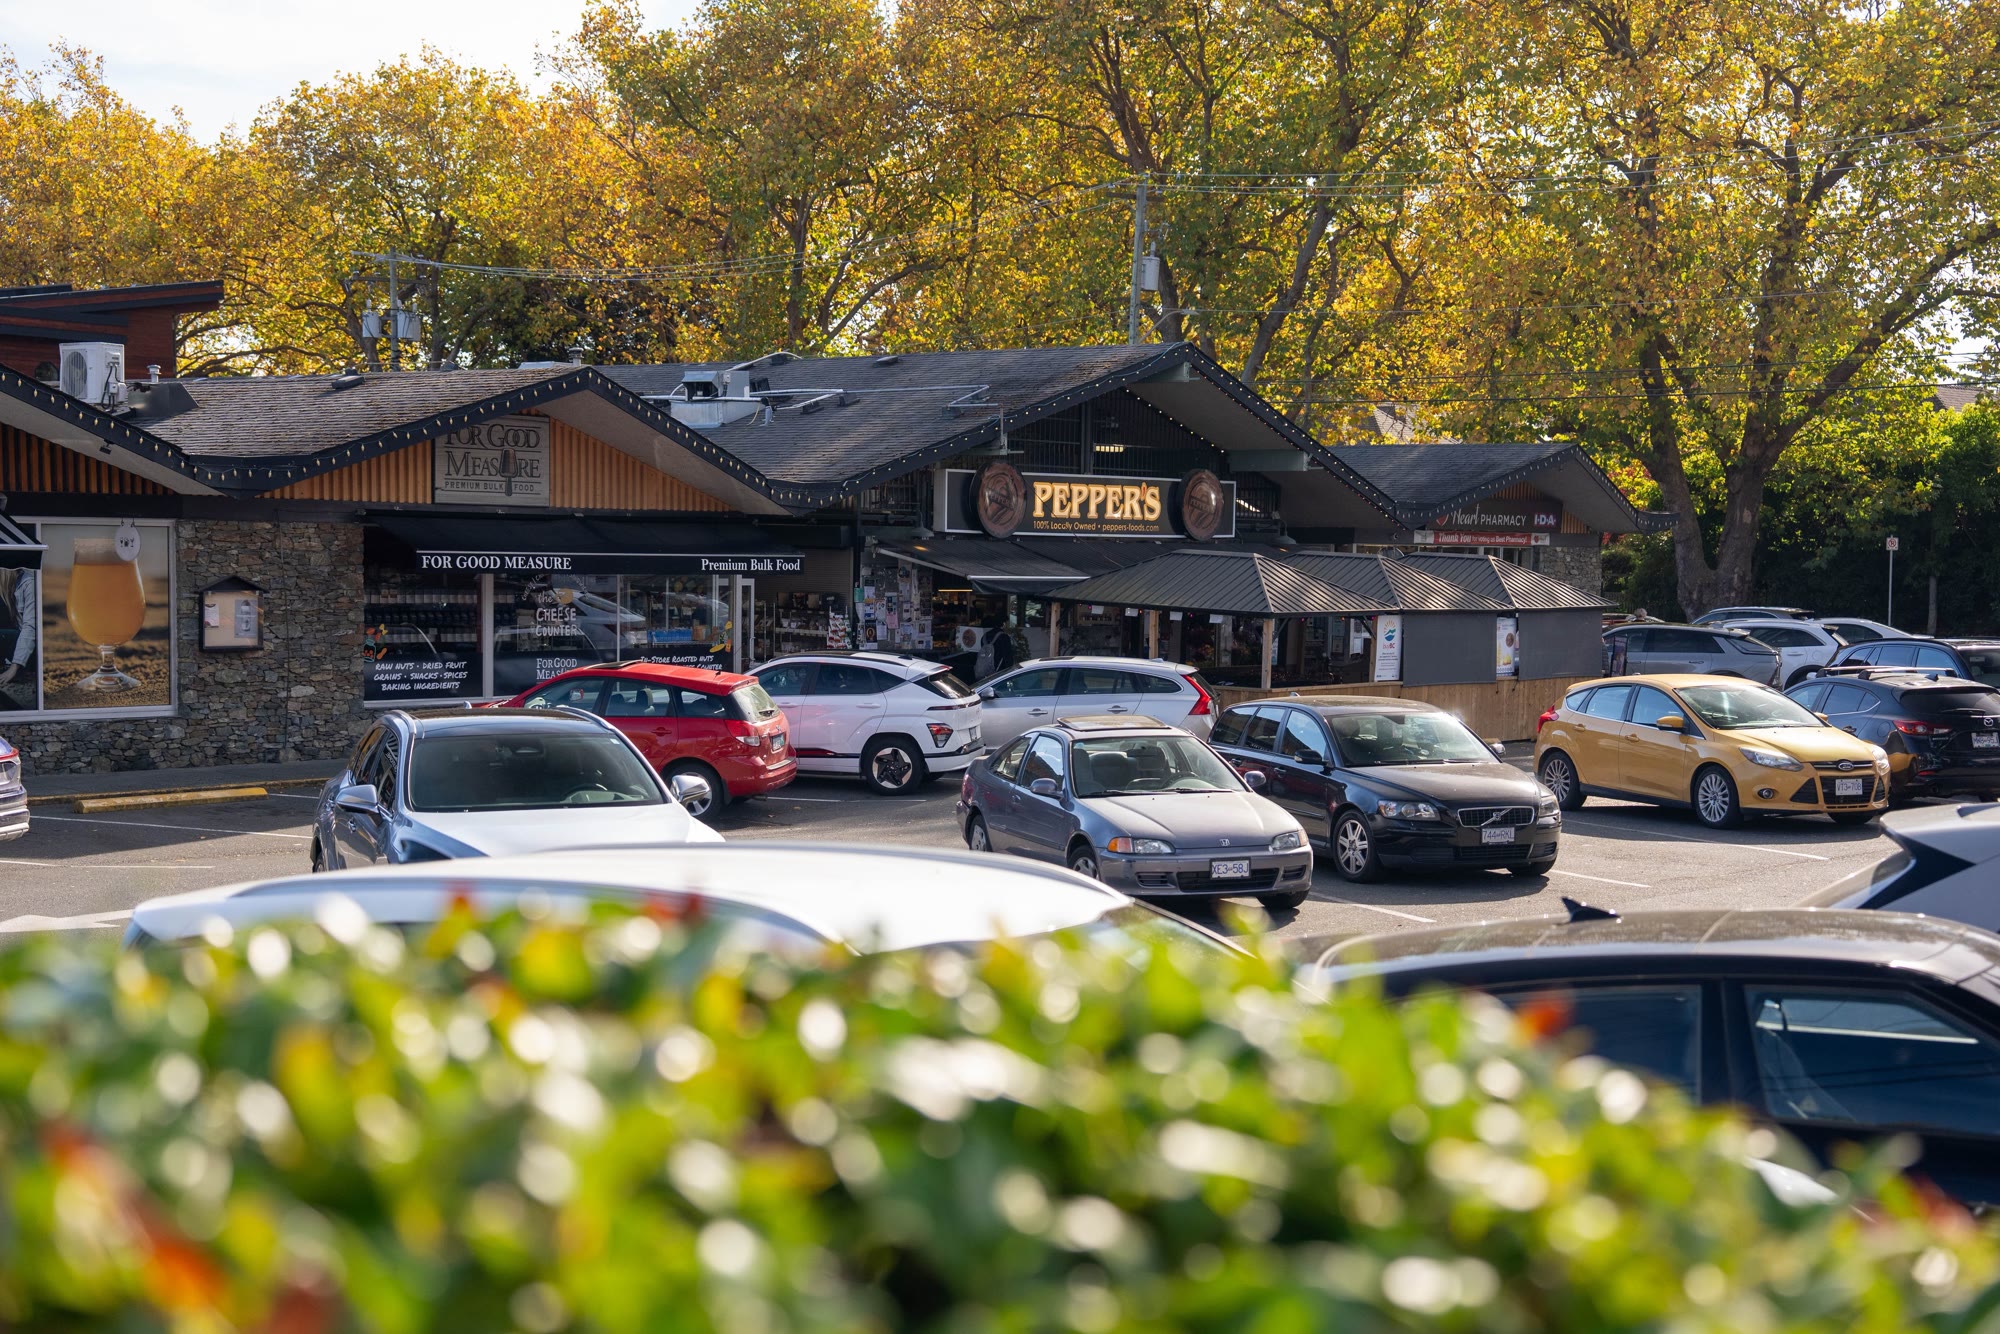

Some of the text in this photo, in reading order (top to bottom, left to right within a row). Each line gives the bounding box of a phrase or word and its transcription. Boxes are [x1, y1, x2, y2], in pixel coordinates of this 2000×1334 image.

[487, 423, 541, 448] GOOD
[444, 450, 541, 478] MEASRE
[444, 481, 535, 492] PREMIUM BULK FOOD
[1032, 481, 1162, 521] PEPPER'S
[1480, 514, 1527, 526] PHARMACY
[1033, 520, 1160, 533] 100% Locally Owned peppers-foods.com
[1496, 535, 1506, 543] Best
[421, 555, 572, 570] FOR GOOD MEASURE
[701, 558, 801, 571] Premium Bulk Food
[536, 607, 577, 622] CHEESE
[535, 624, 578, 637] COUNTER
[553, 656, 578, 668] GOOD
[671, 655, 698, 663] ROASTED
[375, 661, 467, 671] RAW NUTS DRIED FRUIT
[373, 671, 468, 681] GRAINS SNACKS SPICES
[381, 681, 461, 691] BAKING INGREDIENTS
